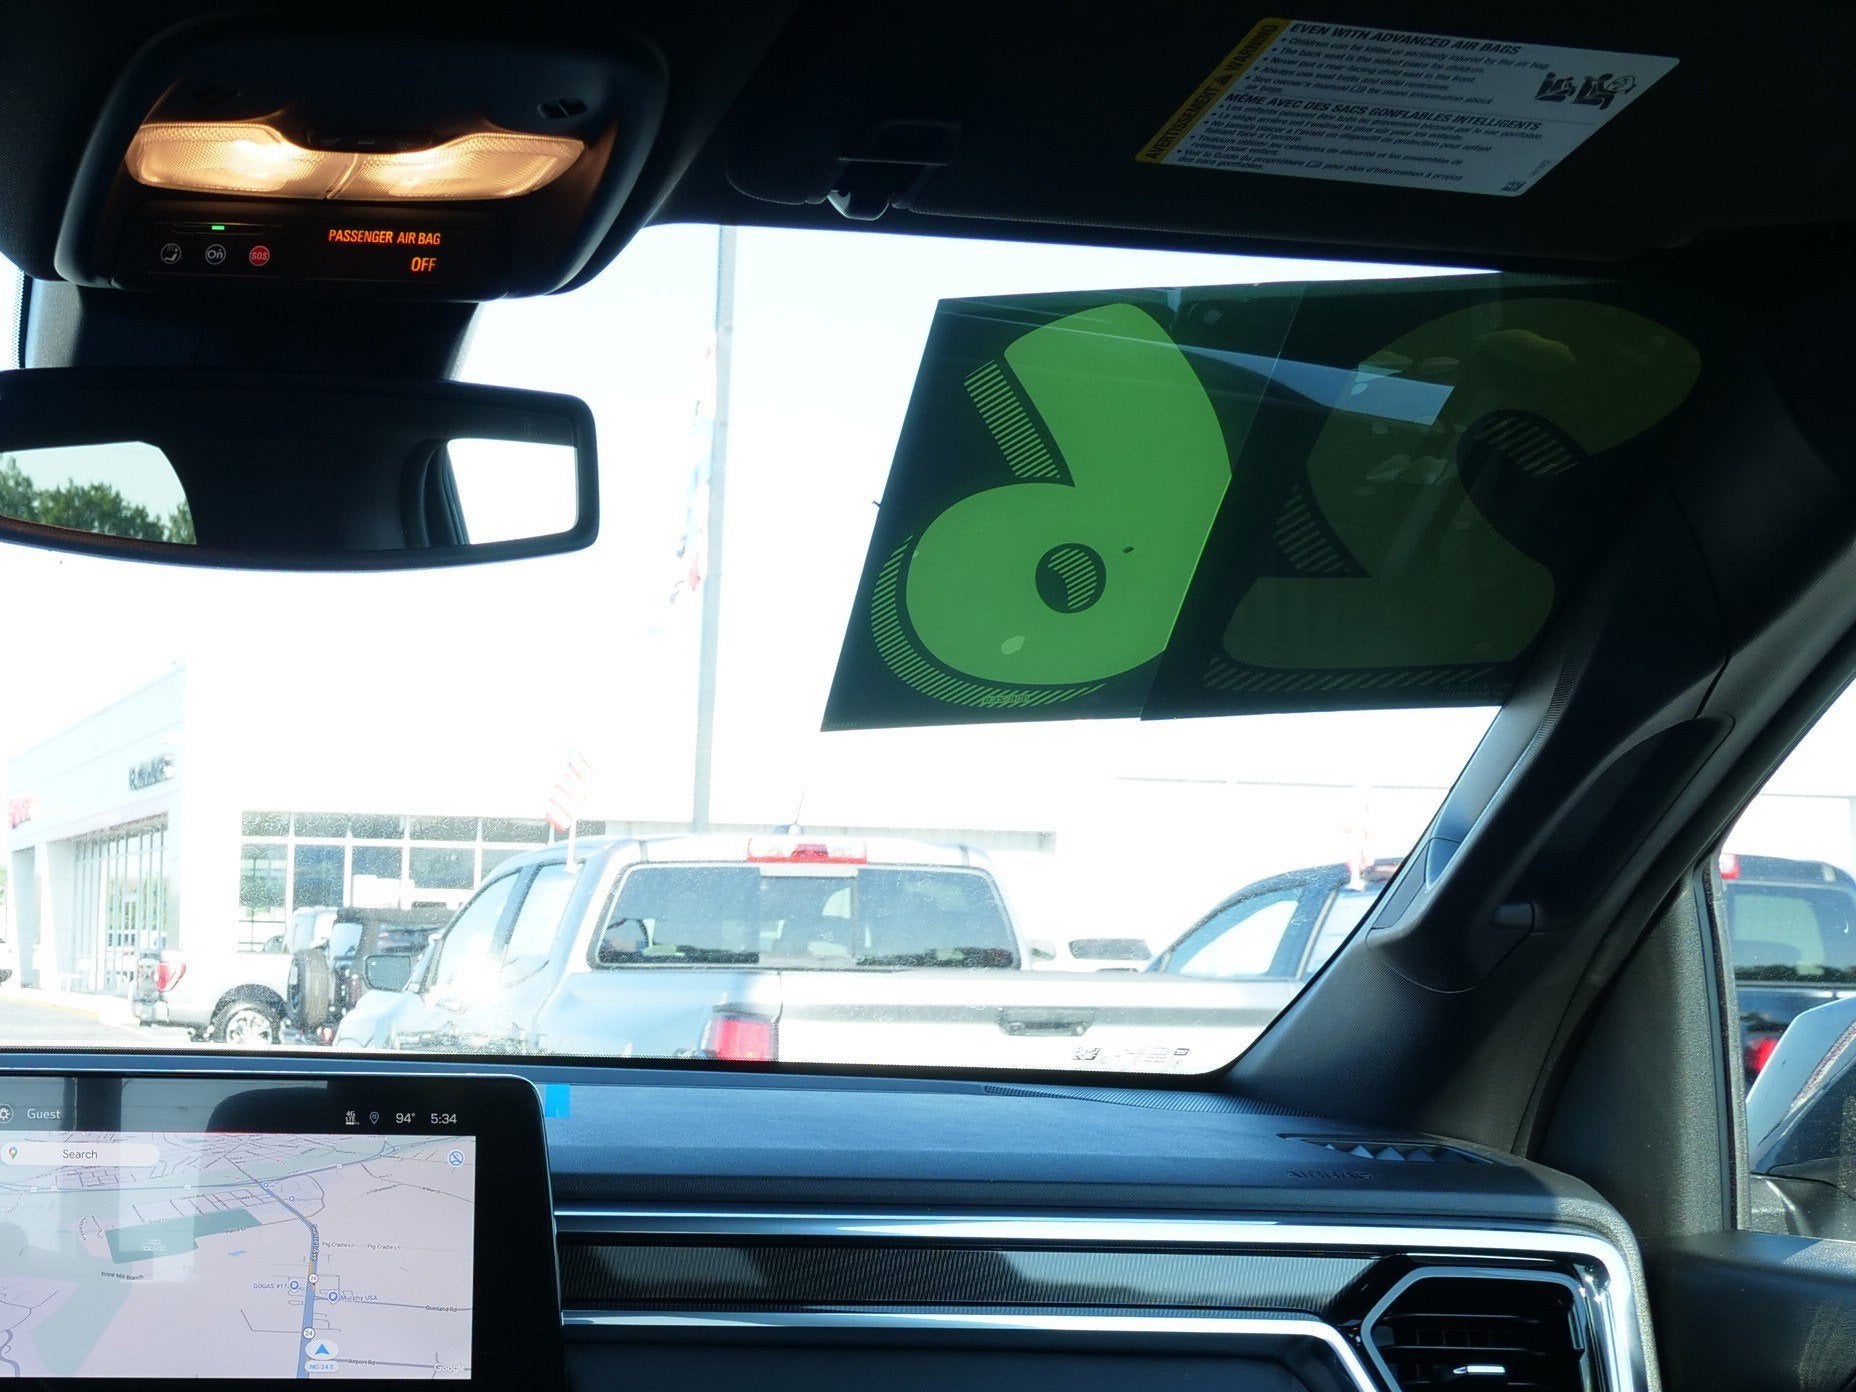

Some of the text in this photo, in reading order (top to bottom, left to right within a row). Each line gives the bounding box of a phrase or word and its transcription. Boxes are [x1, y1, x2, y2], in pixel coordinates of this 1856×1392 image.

[1290, 23, 1522, 55] EVEN WITH ADVANCED AIR BAGS
[328, 229, 442, 246] PASSENGER AIR BAG
[411, 256, 437, 272] OFF
[27, 1108, 60, 1120] Guest
[395, 1112, 416, 1124] 94°
[430, 1113, 457, 1124] 5:34
[62, 1149, 98, 1160] Search
[434, 1363, 465, 1373] Google
